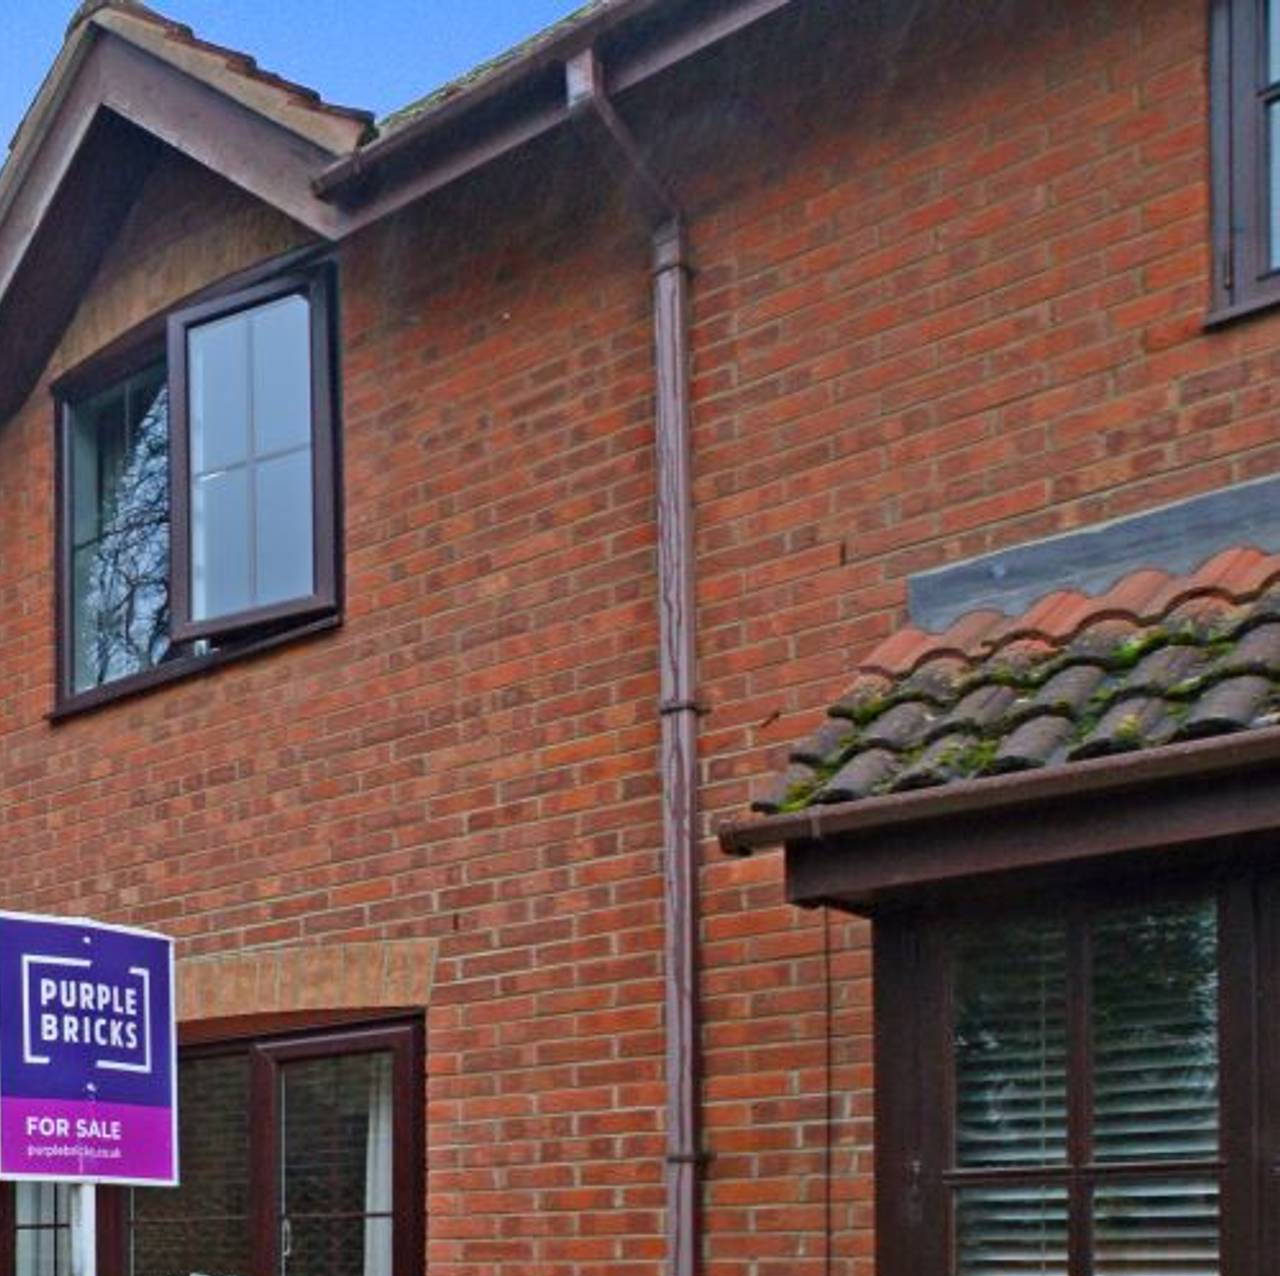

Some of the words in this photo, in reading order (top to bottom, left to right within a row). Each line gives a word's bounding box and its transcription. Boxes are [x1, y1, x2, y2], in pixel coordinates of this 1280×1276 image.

[41, 978, 137, 1016] PURPLE
[41, 1013, 137, 1049] BRICKS
[26, 1116, 69, 1137] FOR
[76, 1117, 121, 1140] SALE
